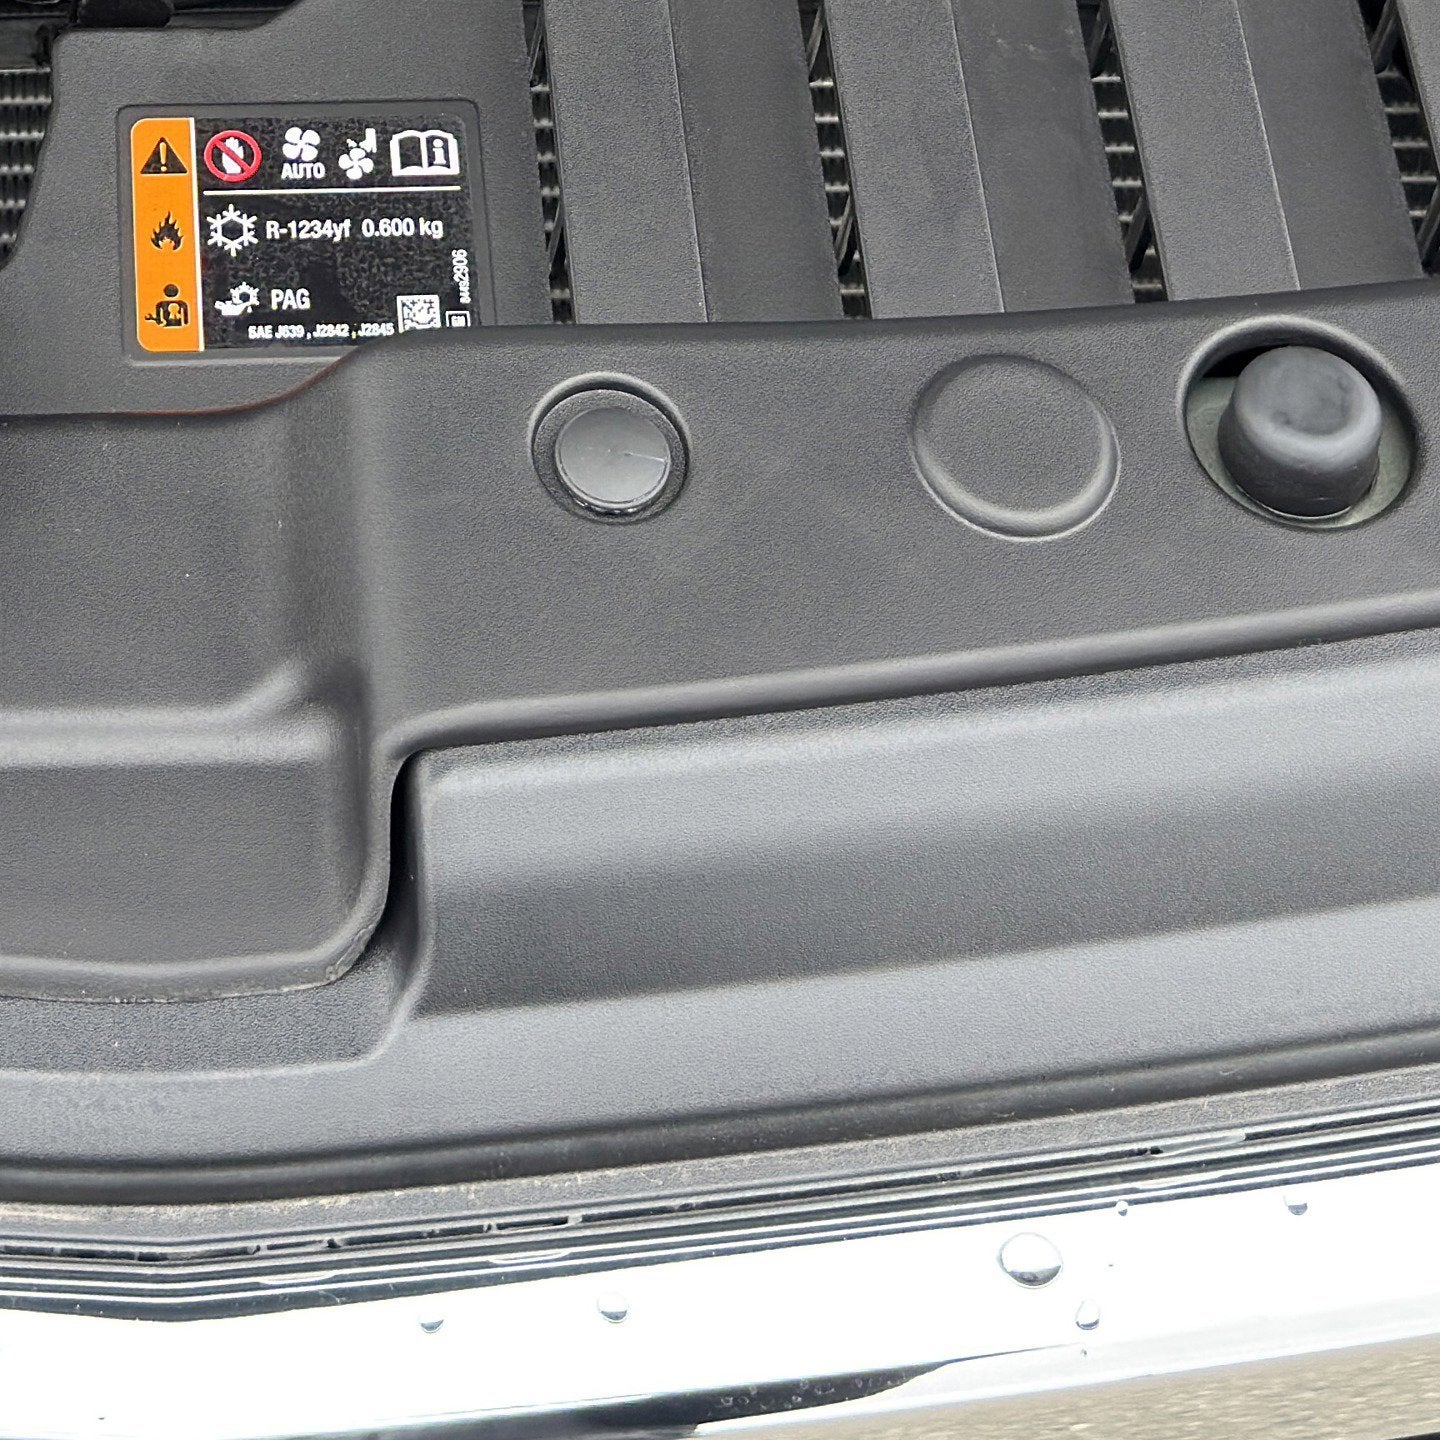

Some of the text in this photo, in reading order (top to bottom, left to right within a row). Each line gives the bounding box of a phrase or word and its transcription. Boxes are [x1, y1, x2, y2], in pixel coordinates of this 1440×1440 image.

[281, 163, 325, 180] AUTO
[266, 217, 443, 242] R-1234yf 0.600 kg
[271, 288, 310, 310] PAG
[248, 325, 270, 339] SAE
[358, 322, 395, 336] J2845
